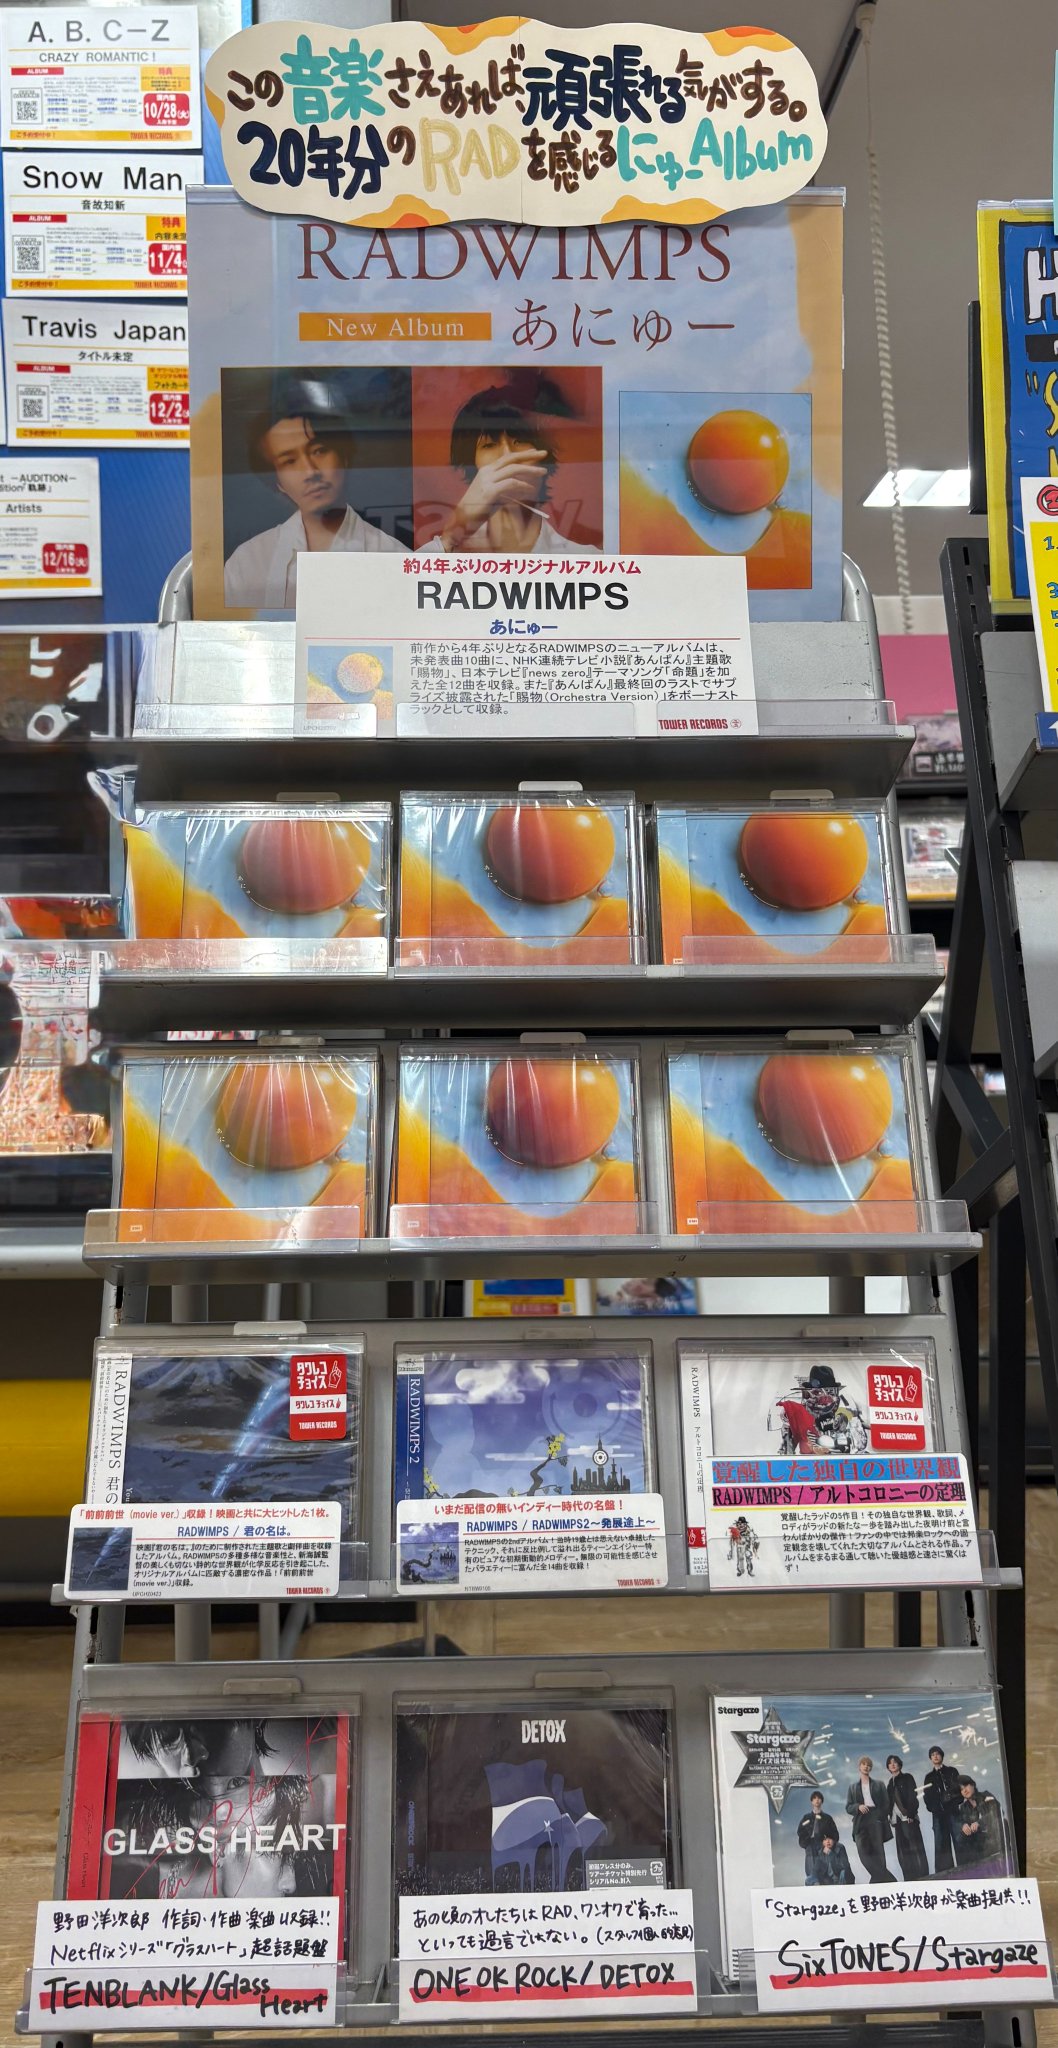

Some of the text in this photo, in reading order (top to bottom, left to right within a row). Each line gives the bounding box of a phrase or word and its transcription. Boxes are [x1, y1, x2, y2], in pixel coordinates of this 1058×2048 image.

[28, 21, 53, 43] A.
[66, 21, 91, 43] B.
[39, 52, 79, 63] CRAZY
[23, 165, 183, 191] Snow Man
[81, 199, 126, 211] 音故知新
[297, 224, 732, 283] RADWIMPS
[21, 315, 186, 343] Travis Japan
[326, 317, 465, 338] New Album
[511, 298, 736, 352] あにゅー
[78, 351, 133, 363] タイトル未定
[6, 503, 42, 513] Artists
[403, 558, 642, 576] 約4年ぶりのオリジナルアルバム
[417, 581, 629, 610] RADWIMPS
[489, 618, 558, 636] あにゅー
[410, 642, 725, 654] 前作から4年ぶりとなるRADWIMPSのニューアルバムは、
[410, 654, 732, 667] 未発表曲10曲に、NHK連続テレビ小説『あんぱん』主題歌
[410, 703, 509, 716] ラックとして収録。
[658, 718, 729, 730] TOWER RECORDS
[296, 1361, 328, 1376] タワレコ
[296, 1376, 328, 1390] チョイス
[873, 1374, 904, 1388] タワレコ
[691, 1367, 701, 1418] RADWIMPS
[874, 1388, 905, 1402] チョイス
[108, 1370, 128, 1469] RADWIMPS
[409, 1378, 420, 1454] RADWIMPS
[713, 1457, 960, 1483] 覚醒した独自の世界観
[712, 1487, 791, 1506] RADWIMPS
[809, 1482, 967, 1504] アルトコロニーの定理
[434, 1500, 623, 1515] いまだ配信の無いインディー時代の名盤！
[178, 1526, 229, 1537] RADWIMPS
[244, 1525, 291, 1537] 君の名は。
[466, 1521, 518, 1532] RADWIMPS
[718, 1706, 760, 1716] Stargaze
[521, 1719, 567, 1743] DETOX
[746, 1733, 801, 1746] Stargaze
[103, 1823, 347, 1856] GLASS HEART
[53, 1910, 150, 1931] 野田洋次郎
[413, 1965, 472, 2000] ONE
[476, 1965, 509, 1986] OK
[260, 1992, 328, 2018] Heart
